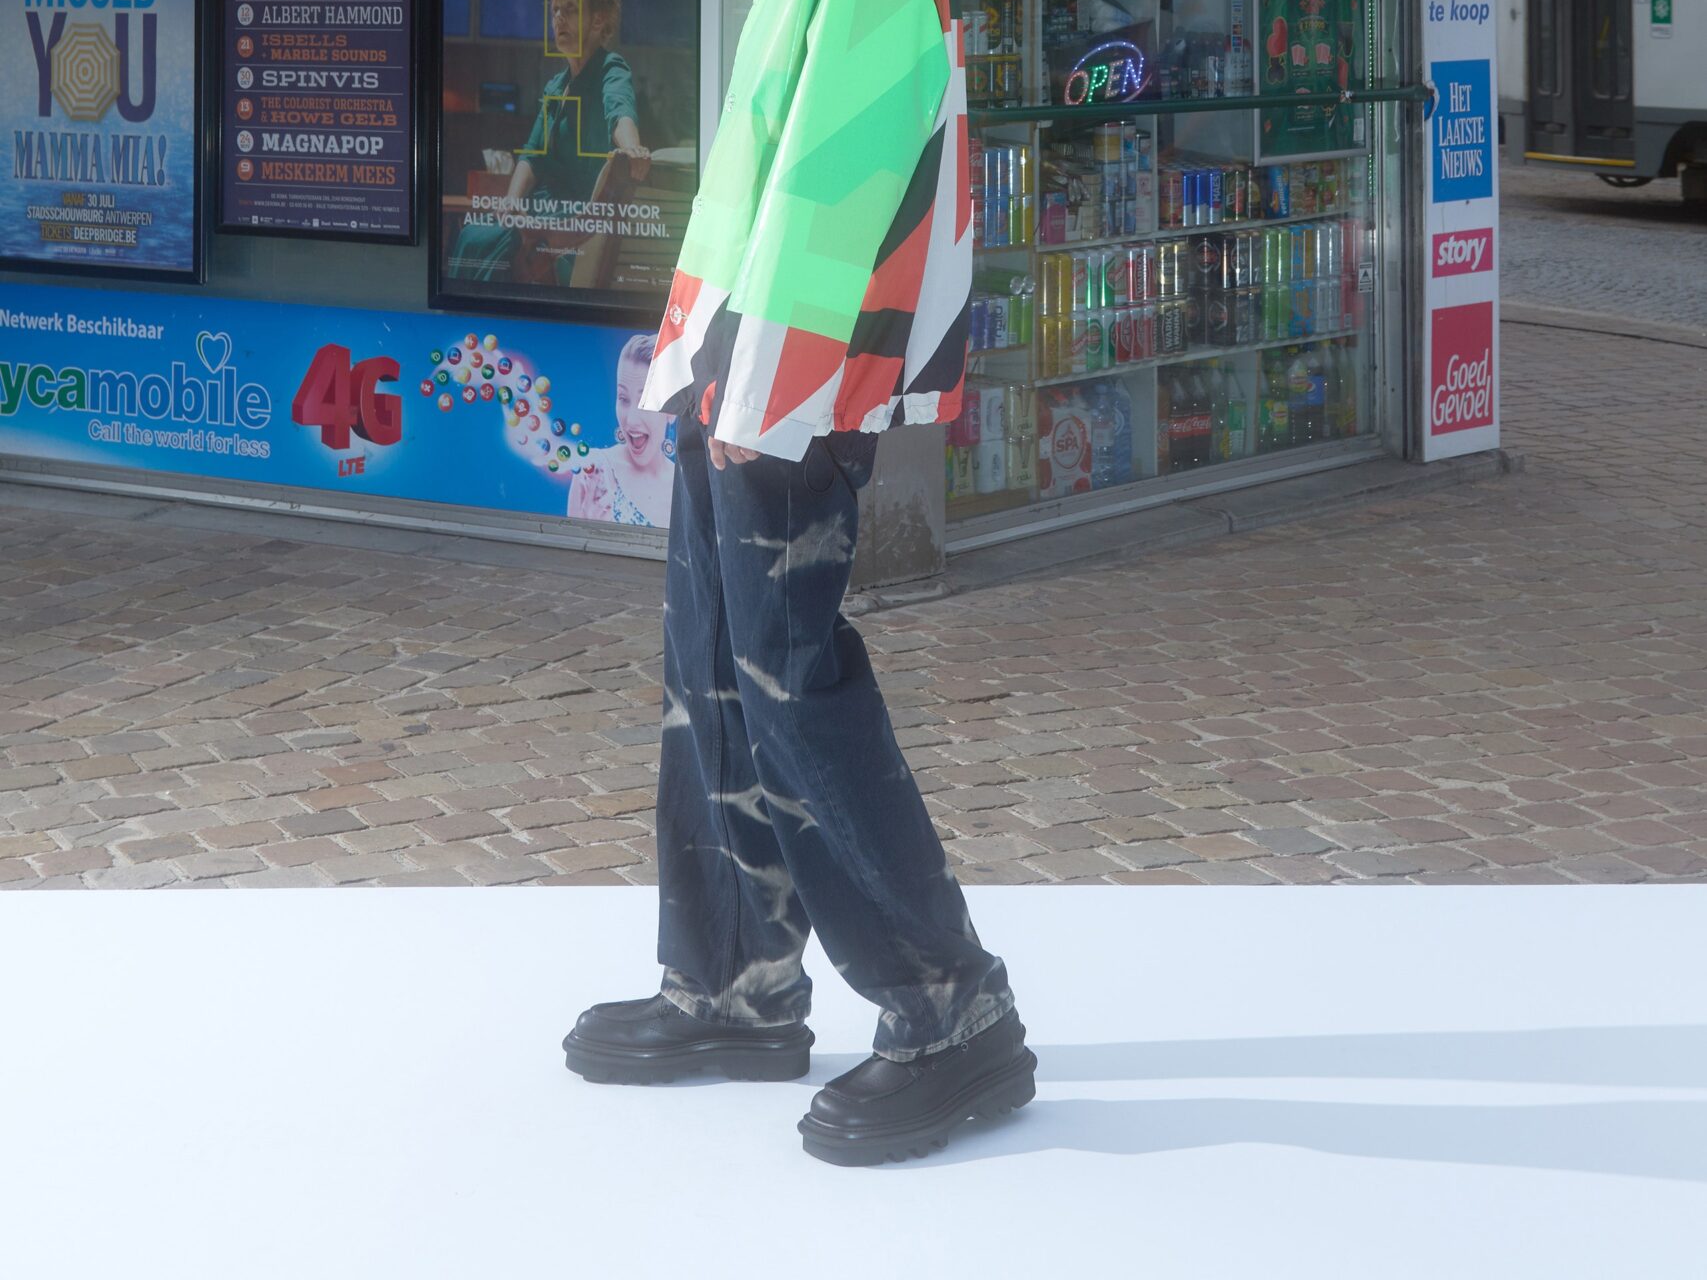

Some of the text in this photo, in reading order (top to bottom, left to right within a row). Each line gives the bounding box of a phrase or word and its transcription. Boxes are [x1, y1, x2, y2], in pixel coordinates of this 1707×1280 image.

[241, 7, 250, 17] 12
[262, 5, 403, 25] ALBERT HAMMOND
[1429, 0, 1490, 25] te koop
[240, 39, 250, 50] 21
[262, 34, 347, 46] ISBELLS
[271, 48, 328, 61] MARBLE
[331, 49, 387, 62] SOUNDS
[240, 71, 250, 81] 30
[262, 70, 379, 88] SPINVIS
[1063, 56, 1141, 106] OPEN
[261, 97, 393, 111] THE COLORIST ORCHESTRA
[270, 111, 334, 124] HOWE
[340, 113, 397, 126] GELB
[262, 133, 383, 155] MAGNAPOP
[14, 131, 167, 187] MAMMA MIA!
[261, 161, 395, 184] MESKEREM MEES
[1213, 176, 1221, 200] MAES
[87, 194, 97, 207] 30
[99, 195, 115, 208] JULI
[472, 195, 660, 221] BOEK NU UW TICKETS VOOR
[27, 207, 152, 225] STADSSCHOUWBURG ANTWERPEN
[464, 211, 670, 239] ALLE VOORSTELLINGEN IN JUNI.
[41, 224, 137, 243] TICKETS DEEPBRIDGE.BE
[1437, 235, 1487, 271] story
[0, 309, 164, 340] Netwerk Beschikbaar
[1165, 310, 1173, 348] WARKA
[1447, 348, 1489, 391] Goed
[292, 343, 402, 450] 4G
[1432, 375, 1491, 427] Gevoel
[88, 419, 270, 459] Call the world for less
[1056, 436, 1079, 453] SPA
[338, 456, 365, 478] LTE
